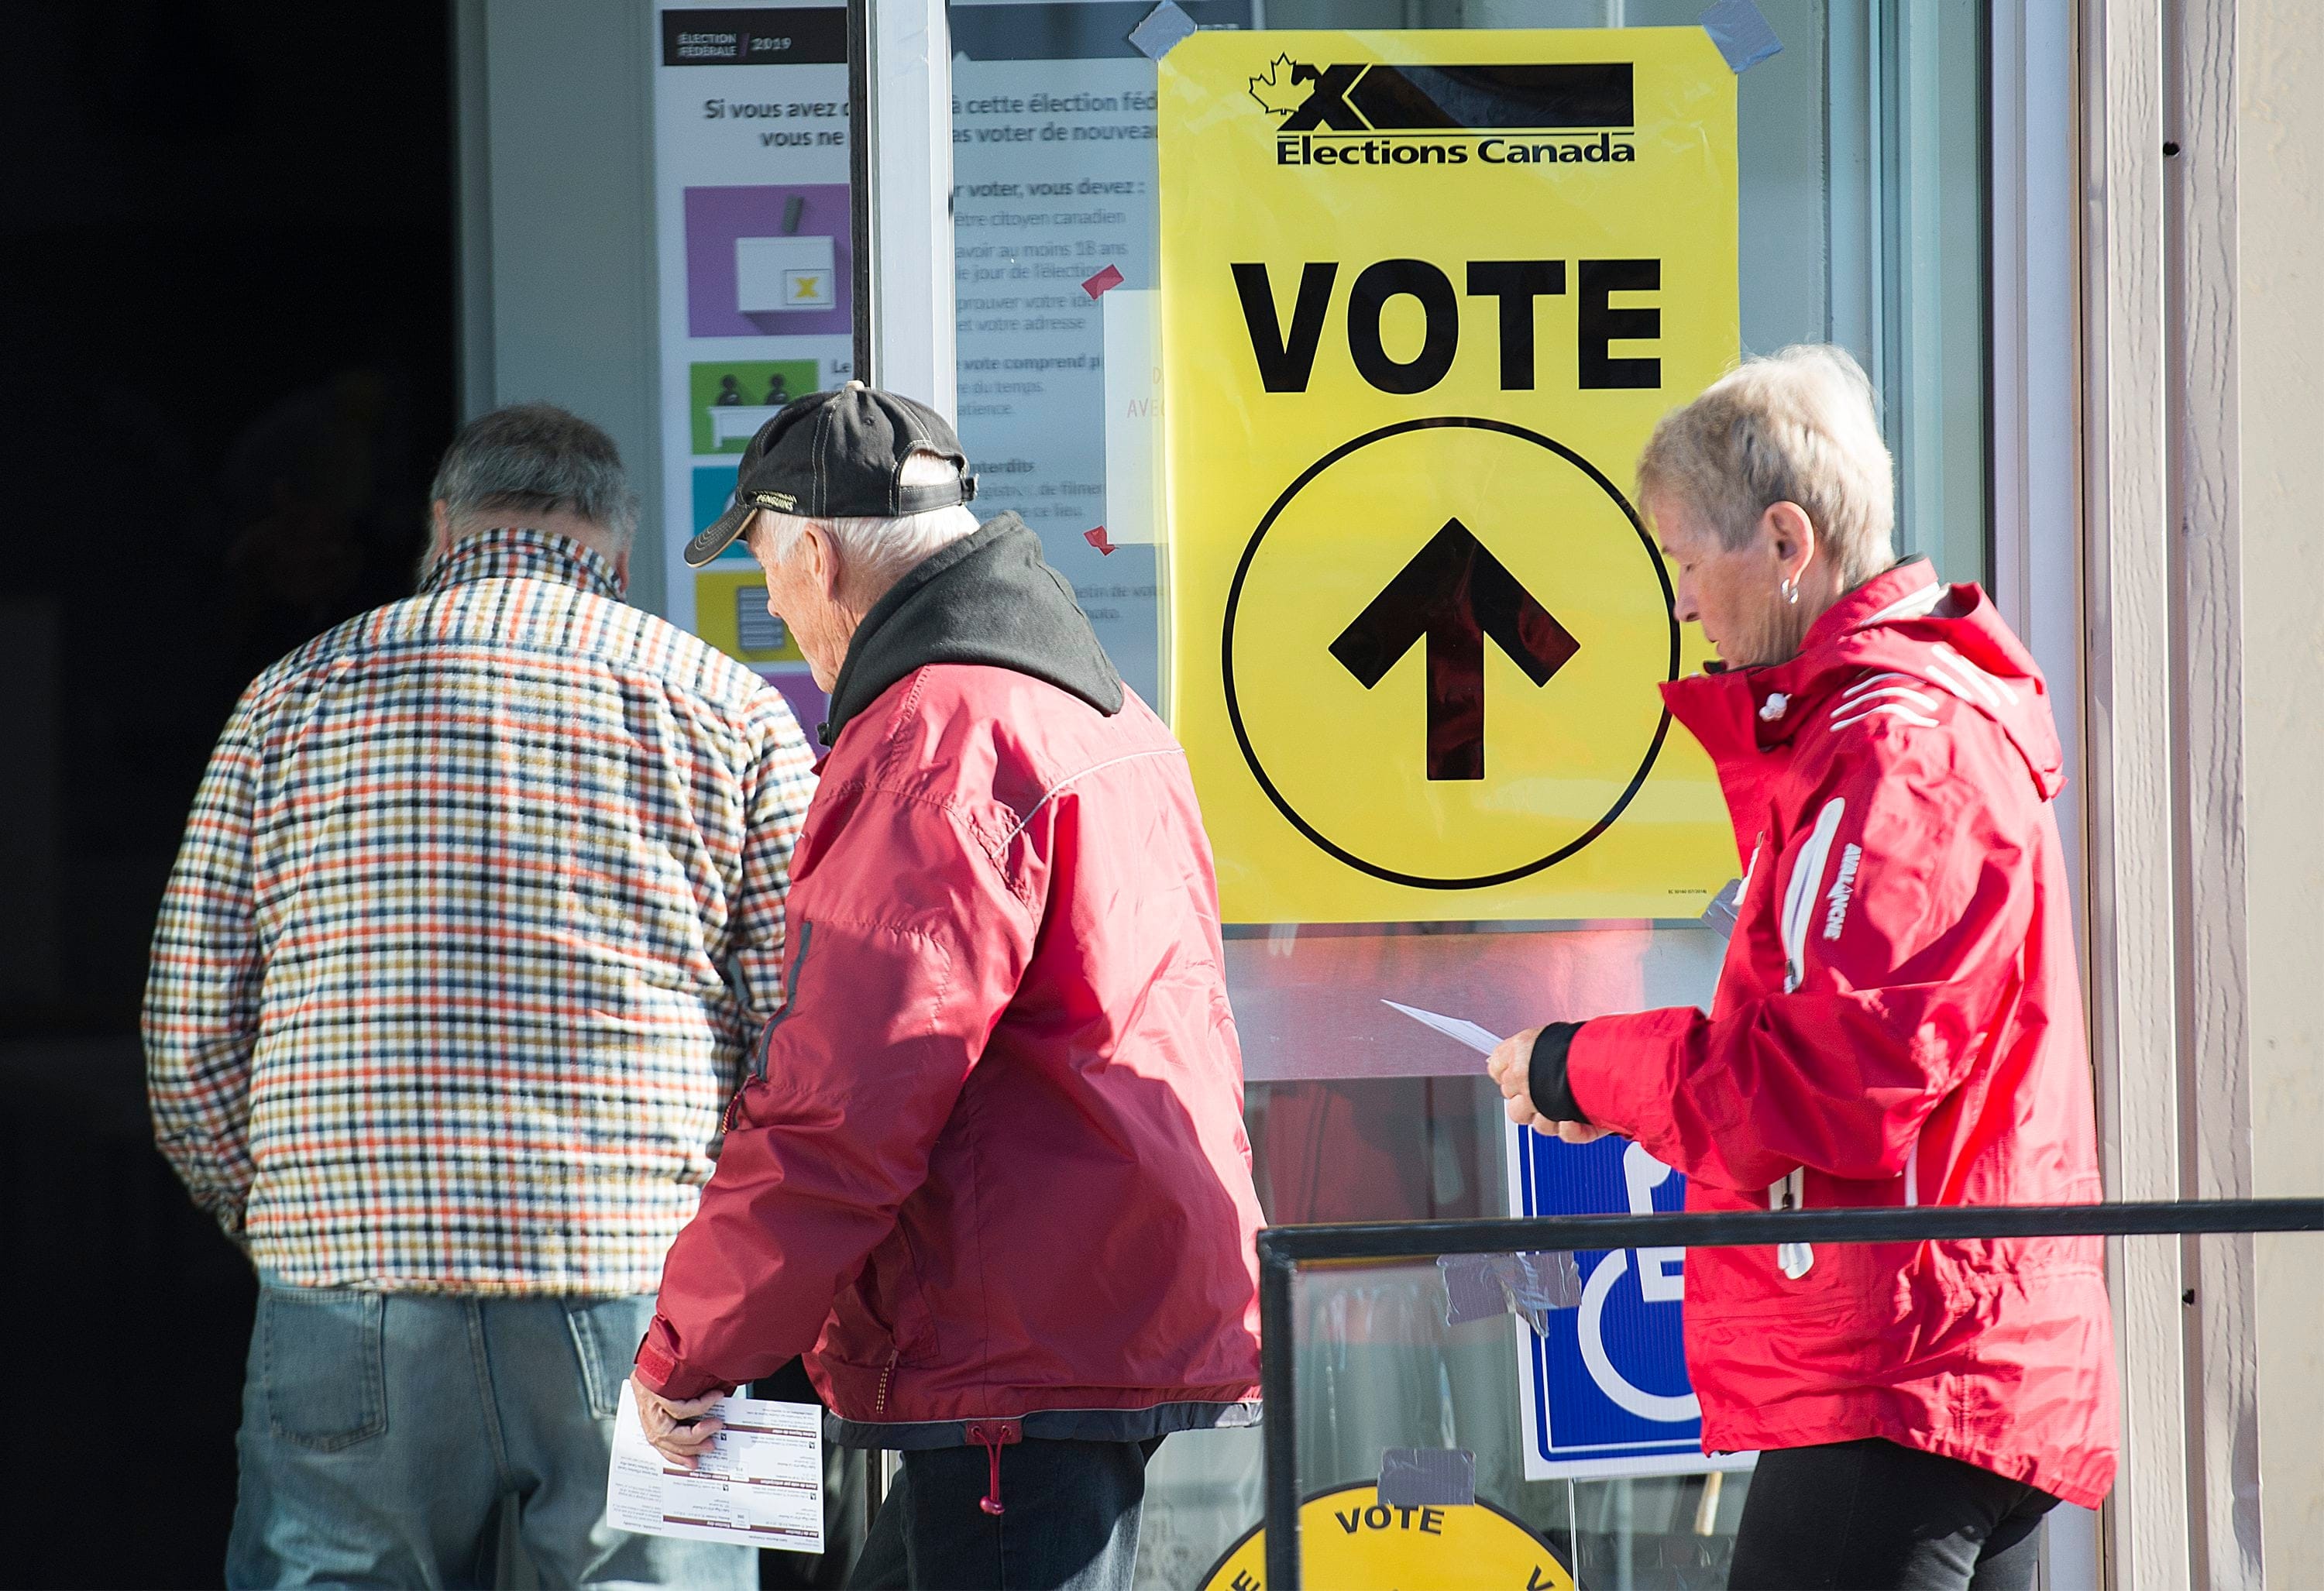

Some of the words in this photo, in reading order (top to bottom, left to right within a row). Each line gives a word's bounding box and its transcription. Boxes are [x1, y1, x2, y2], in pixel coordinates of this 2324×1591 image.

[678, 33, 736, 45] ÉLECTION
[751, 37, 792, 51] 2019
[704, 99, 725, 119] Si
[731, 102, 784, 119] vous
[786, 102, 839, 118] avez
[967, 95, 1025, 115] cette
[1029, 92, 1119, 114] élection
[759, 131, 813, 147] vous
[817, 130, 844, 146] ne
[977, 124, 1037, 143] voter
[1041, 121, 1069, 143] de
[1277, 134, 1469, 166] Elections
[1477, 132, 1636, 165] Canada
[969, 180, 1025, 199] voter,
[1029, 182, 1074, 196] vous
[1081, 177, 1135, 195] devez
[1053, 208, 1126, 225] canadien
[1023, 242, 1073, 257] moins
[972, 265, 1007, 283] jour
[1009, 263, 1030, 279] de
[1025, 296, 1067, 309] votre
[978, 318, 1020, 332] votre
[1023, 315, 1086, 331] adresse
[1230, 259, 1662, 395] VOTE
[831, 359, 852, 373] Le
[964, 357, 1000, 370] vote
[1003, 354, 1086, 372] comprend
[756, 493, 795, 512] PENGUINS
[1823, 842, 1862, 941] AVALANCHE
[1334, 1505, 1446, 1536] VOTE
